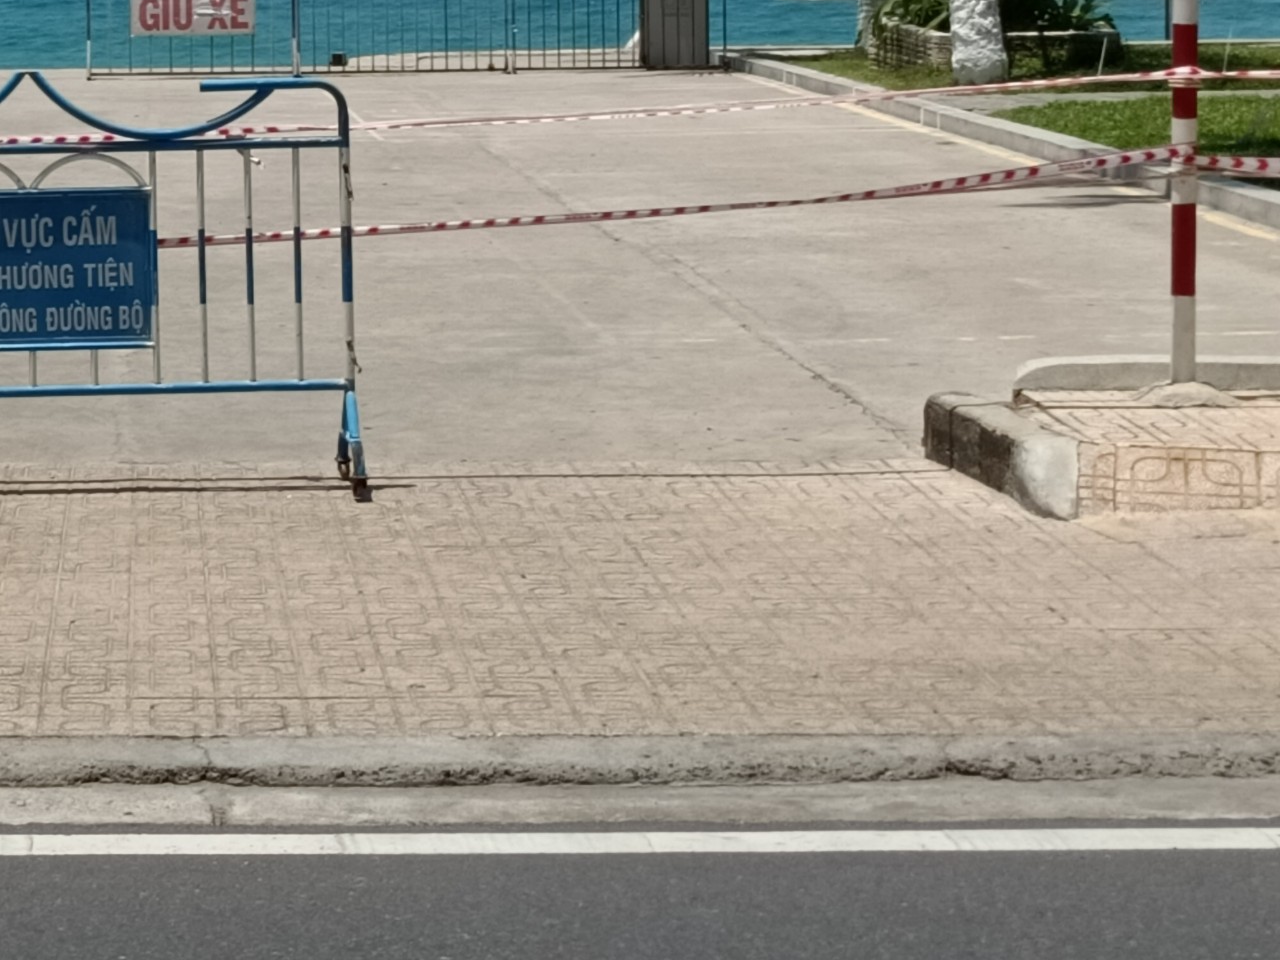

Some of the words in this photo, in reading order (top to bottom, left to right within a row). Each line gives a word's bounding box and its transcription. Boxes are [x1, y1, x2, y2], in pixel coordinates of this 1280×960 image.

[3, 213, 54, 253] VỰC
[62, 205, 117, 246] CẤM
[83, 257, 134, 291] TIỆN
[46, 300, 113, 331] ĐƯỜNG
[119, 299, 144, 333] BỘ
